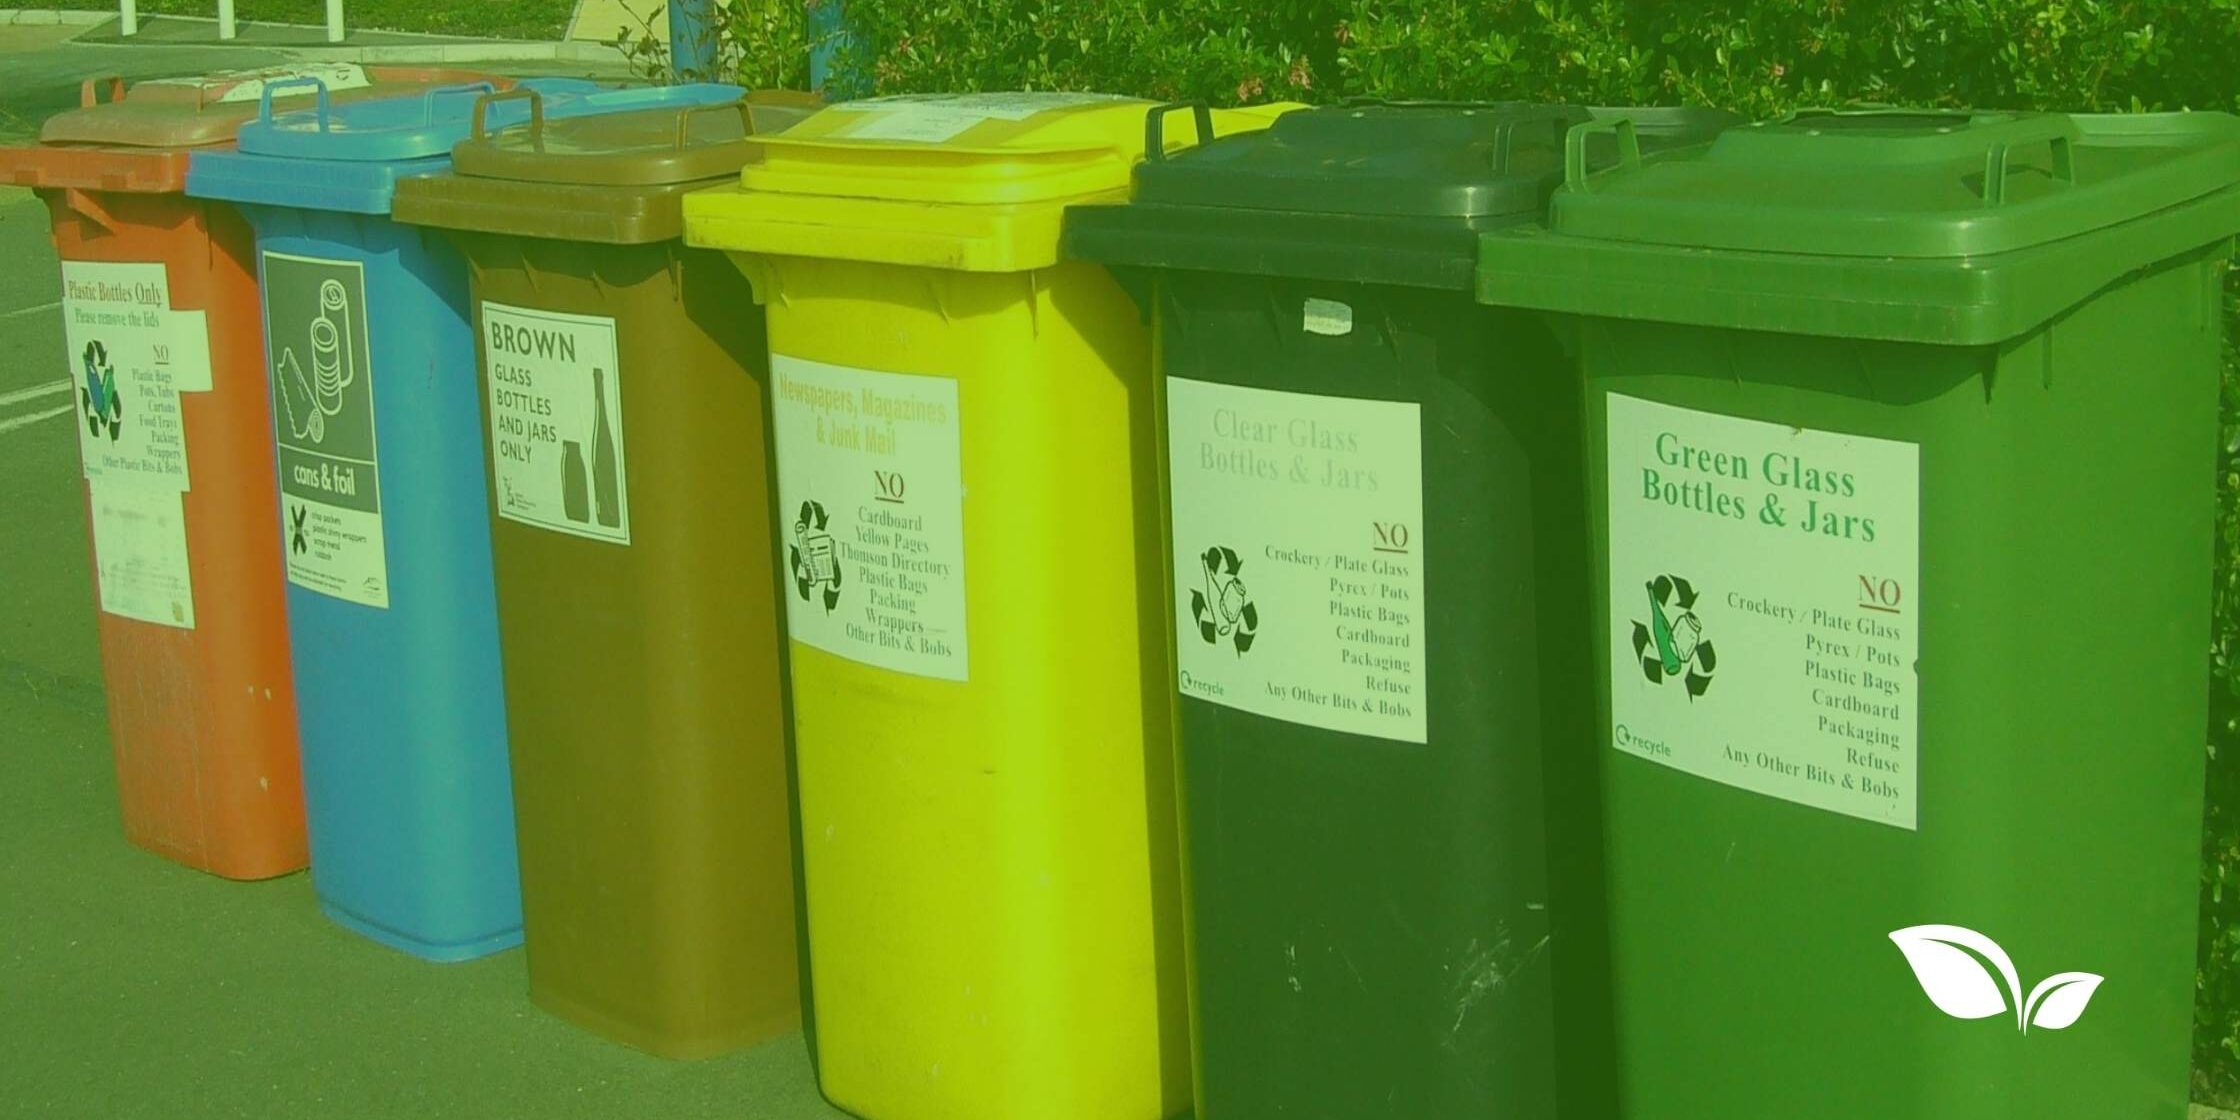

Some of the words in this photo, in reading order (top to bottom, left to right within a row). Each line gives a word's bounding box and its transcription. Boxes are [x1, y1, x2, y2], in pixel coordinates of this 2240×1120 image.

[69, 280, 97, 301] Plastic
[98, 281, 132, 302] Bottles
[135, 282, 161, 308] Only
[75, 307, 97, 325] Please
[98, 313, 126, 327] remove
[128, 311, 142, 328] the
[143, 311, 160, 328] lids
[153, 344, 169, 361] NO
[491, 321, 577, 363] BROWN
[495, 363, 533, 388] GLASS
[496, 388, 552, 417] BOTTLES
[779, 371, 859, 419] Newspapers,
[862, 387, 948, 426] Magazines
[151, 430, 180, 447] Packing
[499, 414, 524, 437] AND
[526, 418, 557, 444] JARS
[815, 415, 826, 445] &
[830, 418, 861, 451] Junk
[864, 425, 897, 457] Mail
[1213, 408, 1279, 444] Clear
[1287, 418, 1359, 453] Glass
[501, 439, 532, 465] ONLY
[1655, 432, 1749, 481] Green
[1762, 451, 1856, 498] Glass
[294, 465, 319, 488] cans
[321, 462, 332, 492] &
[333, 465, 356, 496] foil
[1201, 443, 1281, 481] Bottles
[1288, 455, 1310, 485] &
[1320, 459, 1380, 493] Jars
[874, 470, 905, 500] NO
[858, 505, 922, 531] Cardboard
[1642, 467, 1746, 521] Bottles
[1759, 493, 1787, 528] &
[1801, 500, 1877, 543] Jars
[855, 525, 890, 547] Yellow
[895, 532, 929, 554] Pages
[1373, 521, 1408, 549] NO
[839, 541, 888, 567] Thomson
[892, 552, 950, 580] Directory
[1265, 544, 1321, 570] Crockery
[1335, 554, 1368, 574] Plate
[1372, 558, 1409, 578] Glass
[859, 565, 895, 589] Plastic
[900, 574, 928, 595] Bags
[1330, 577, 1367, 598] Pyrex
[1381, 583, 1410, 602] Pots
[1858, 574, 1901, 608] NO
[870, 588, 917, 615] Packing
[1330, 600, 1373, 622] Plastic
[1378, 606, 1410, 627] Bags
[1727, 591, 1797, 625] Crockery
[1812, 608, 1851, 632] Plate
[1857, 617, 1901, 642] Glass
[866, 606, 924, 634] Wrappers
[846, 621, 874, 645] Other
[879, 630, 901, 650] Bits
[904, 635, 914, 652] &
[920, 636, 952, 658] Bobs
[1336, 625, 1410, 649] Cardboard
[1806, 633, 1852, 657] Pyrex
[1867, 645, 1901, 668] Pots
[1341, 648, 1411, 674] Packaging
[1193, 679, 1225, 697] recycle
[1366, 675, 1411, 695] Refuse
[1805, 659, 1857, 687] Plastic
[1863, 671, 1901, 698] Bags
[1264, 680, 1288, 700] Any
[1291, 685, 1329, 706] Other
[1333, 693, 1358, 712] Bits
[1361, 698, 1374, 714] &
[1379, 699, 1412, 719] Bobs
[1812, 688, 1900, 722] Cardboard
[1632, 735, 1672, 757] recycle
[1818, 714, 1901, 751] Packaging
[1722, 744, 1751, 769] Any
[1756, 751, 1801, 777] Other
[1806, 763, 1836, 786] Bits
[1841, 773, 1855, 791] &
[1861, 776, 1900, 799] Bobs
[1847, 747, 1901, 774] Refuse
